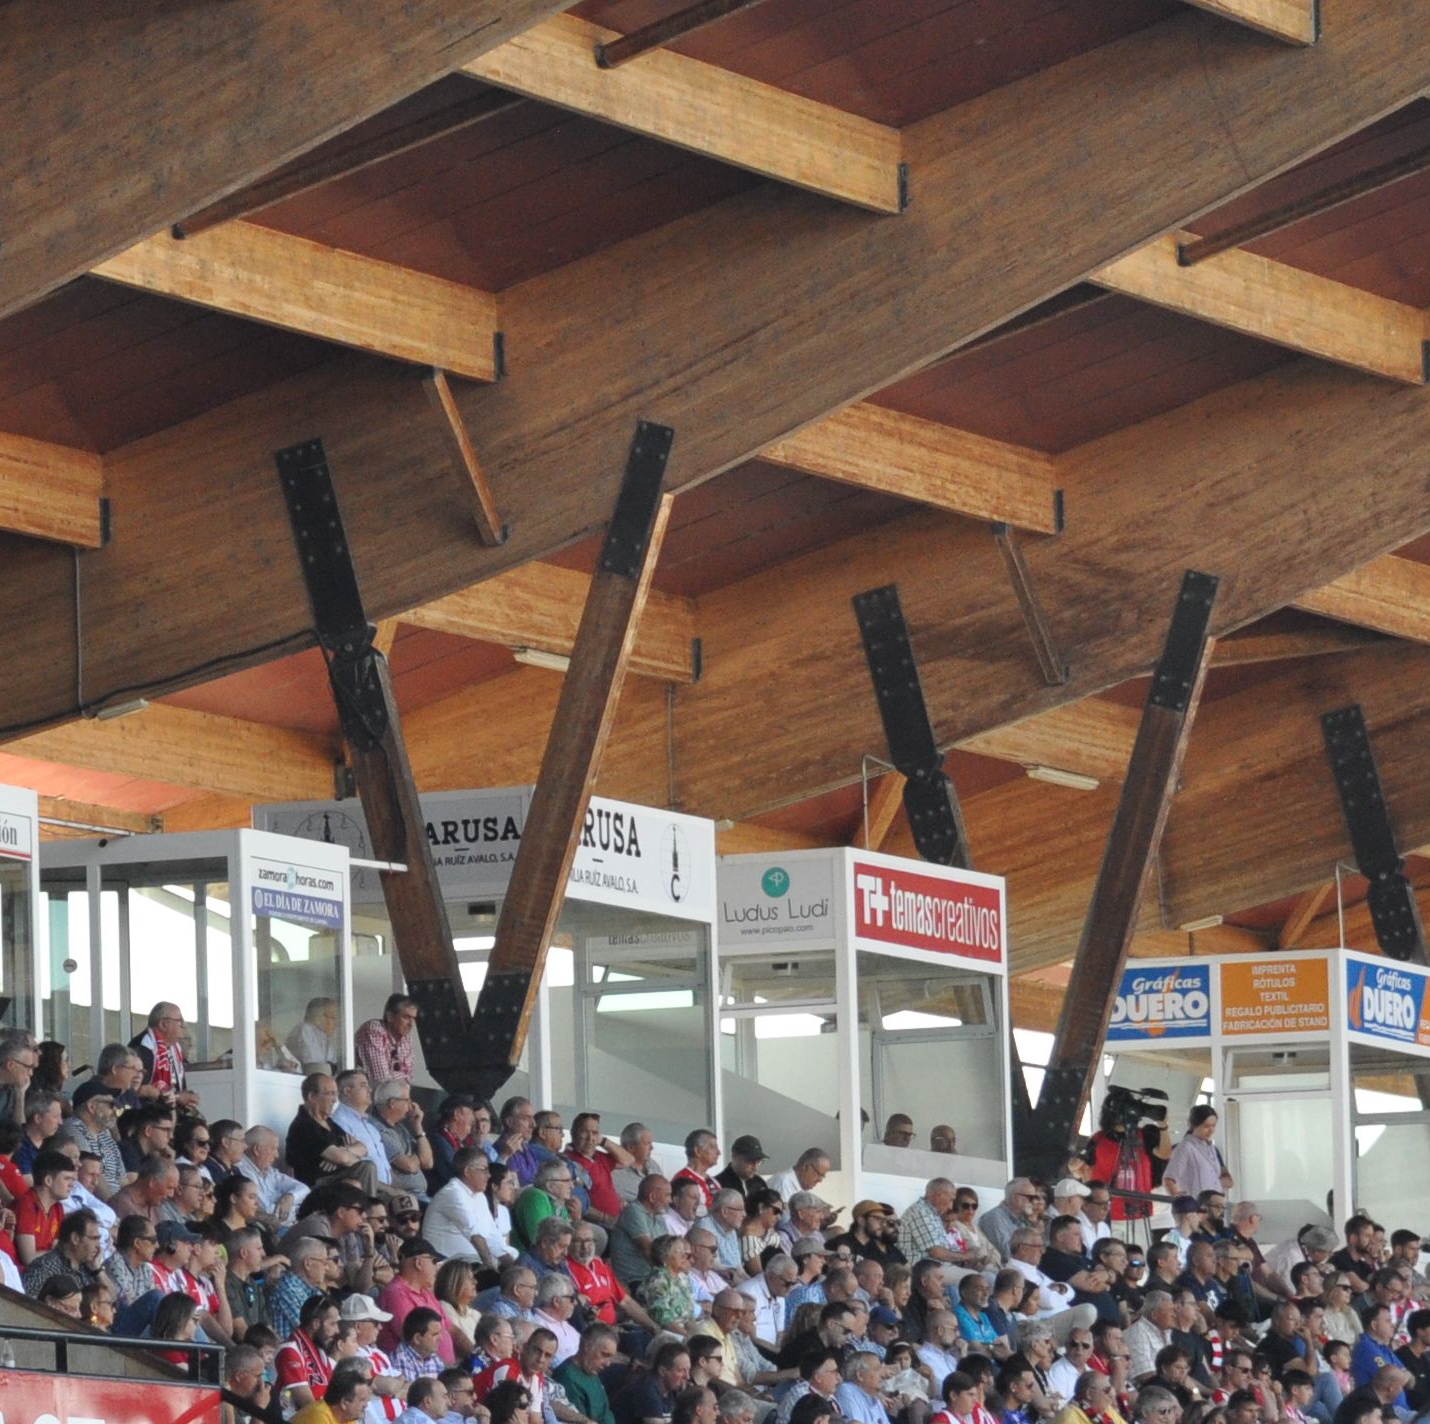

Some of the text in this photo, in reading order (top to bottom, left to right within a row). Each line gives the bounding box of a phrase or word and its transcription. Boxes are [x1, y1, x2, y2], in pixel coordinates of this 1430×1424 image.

[425, 817, 521, 846] ARUSA
[264, 892, 275, 908] EL
[275, 891, 290, 911] DÍA
[291, 896, 303, 913] DE
[303, 898, 339, 919] ZAMORA
[724, 898, 829, 923] Ludus Ludi
[890, 880, 999, 950] temascreativos
[1132, 970, 1201, 993] Gráficas
[1251, 964, 1296, 976] IMPRENTA
[1376, 967, 1411, 991] Gráficas
[1253, 976, 1295, 989] RÓTULOS
[1111, 991, 1209, 1023] DUERO
[1260, 991, 1289, 1002] TEXTIL
[1363, 986, 1415, 1030] DUERO
[1226, 1003, 1325, 1018] REGALO PUBLICITARIO
[1223, 1017, 1328, 1031] FABRICACIÓN DE STAND
